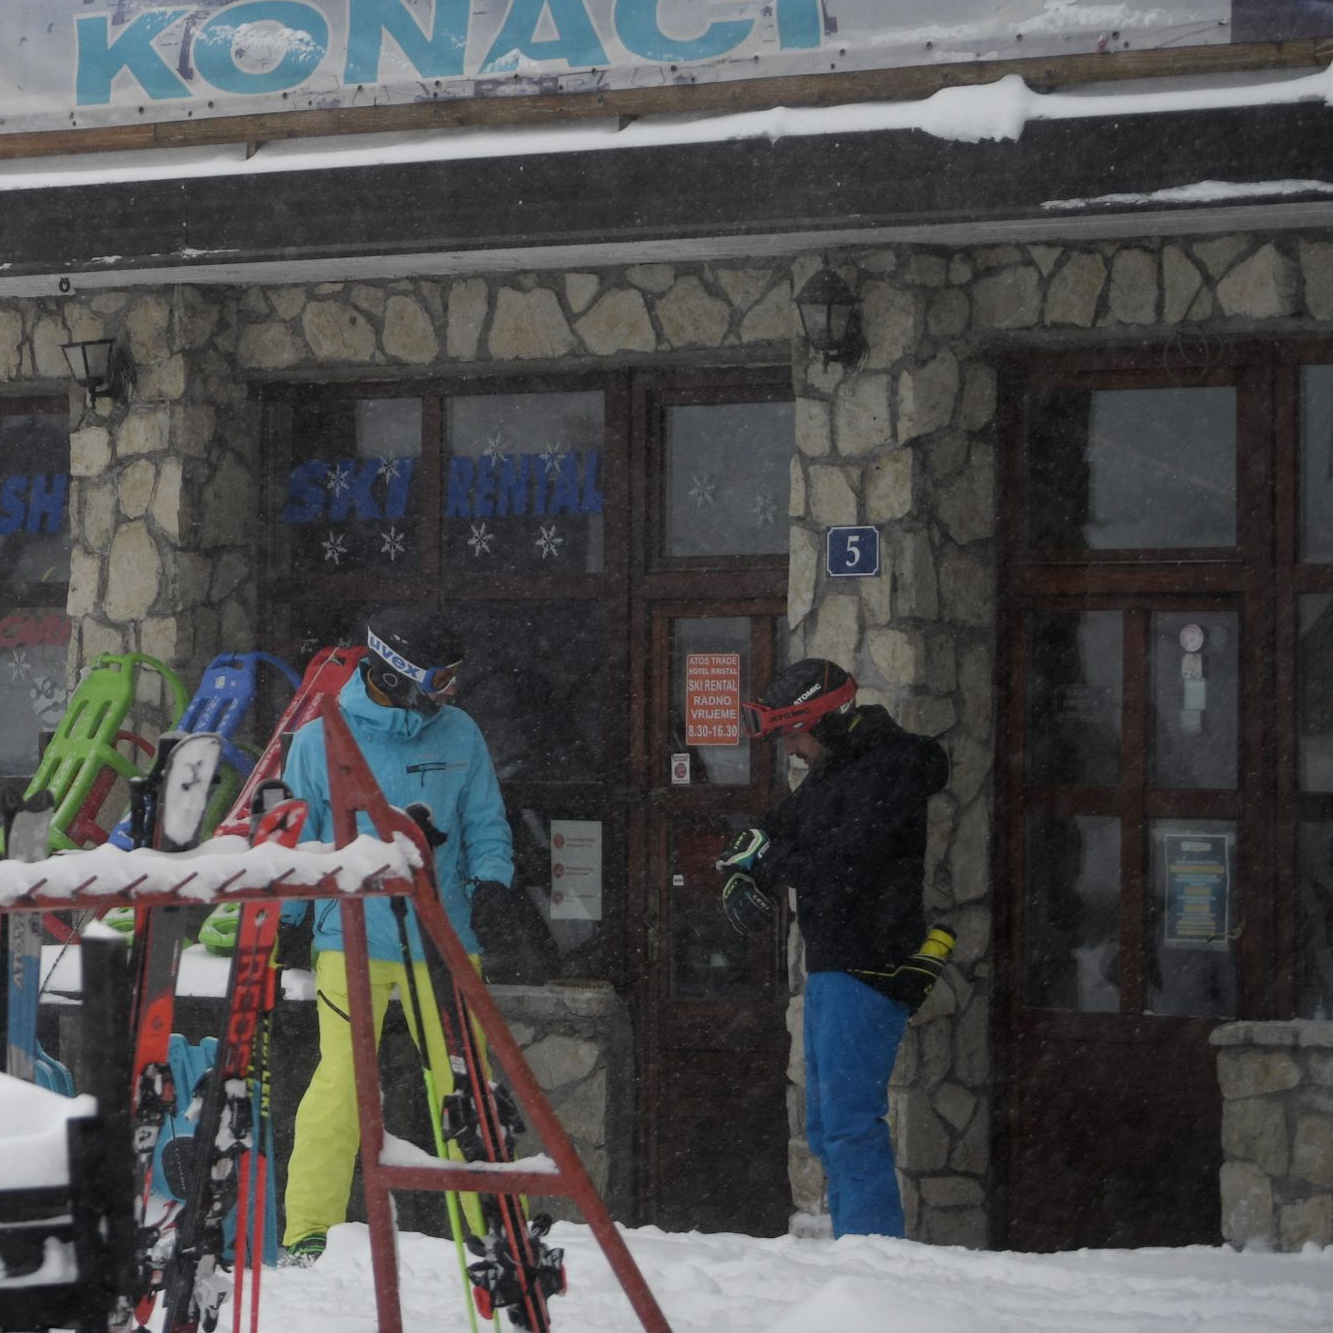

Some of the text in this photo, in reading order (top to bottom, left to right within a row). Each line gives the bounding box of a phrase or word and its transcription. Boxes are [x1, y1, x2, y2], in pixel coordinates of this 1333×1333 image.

[282, 450, 604, 524] SKI RENTAL
[845, 535, 861, 567] 5
[368, 636, 421, 679] uvex
[689, 656, 738, 665] ATOS TRADE
[688, 667, 738, 675] HOTEL KRISTAL
[688, 679, 738, 691] SKI RENTAL
[693, 695, 732, 706] RADNO
[691, 709, 737, 719] VRIJEME
[688, 724, 738, 738] 8.30-16.30
